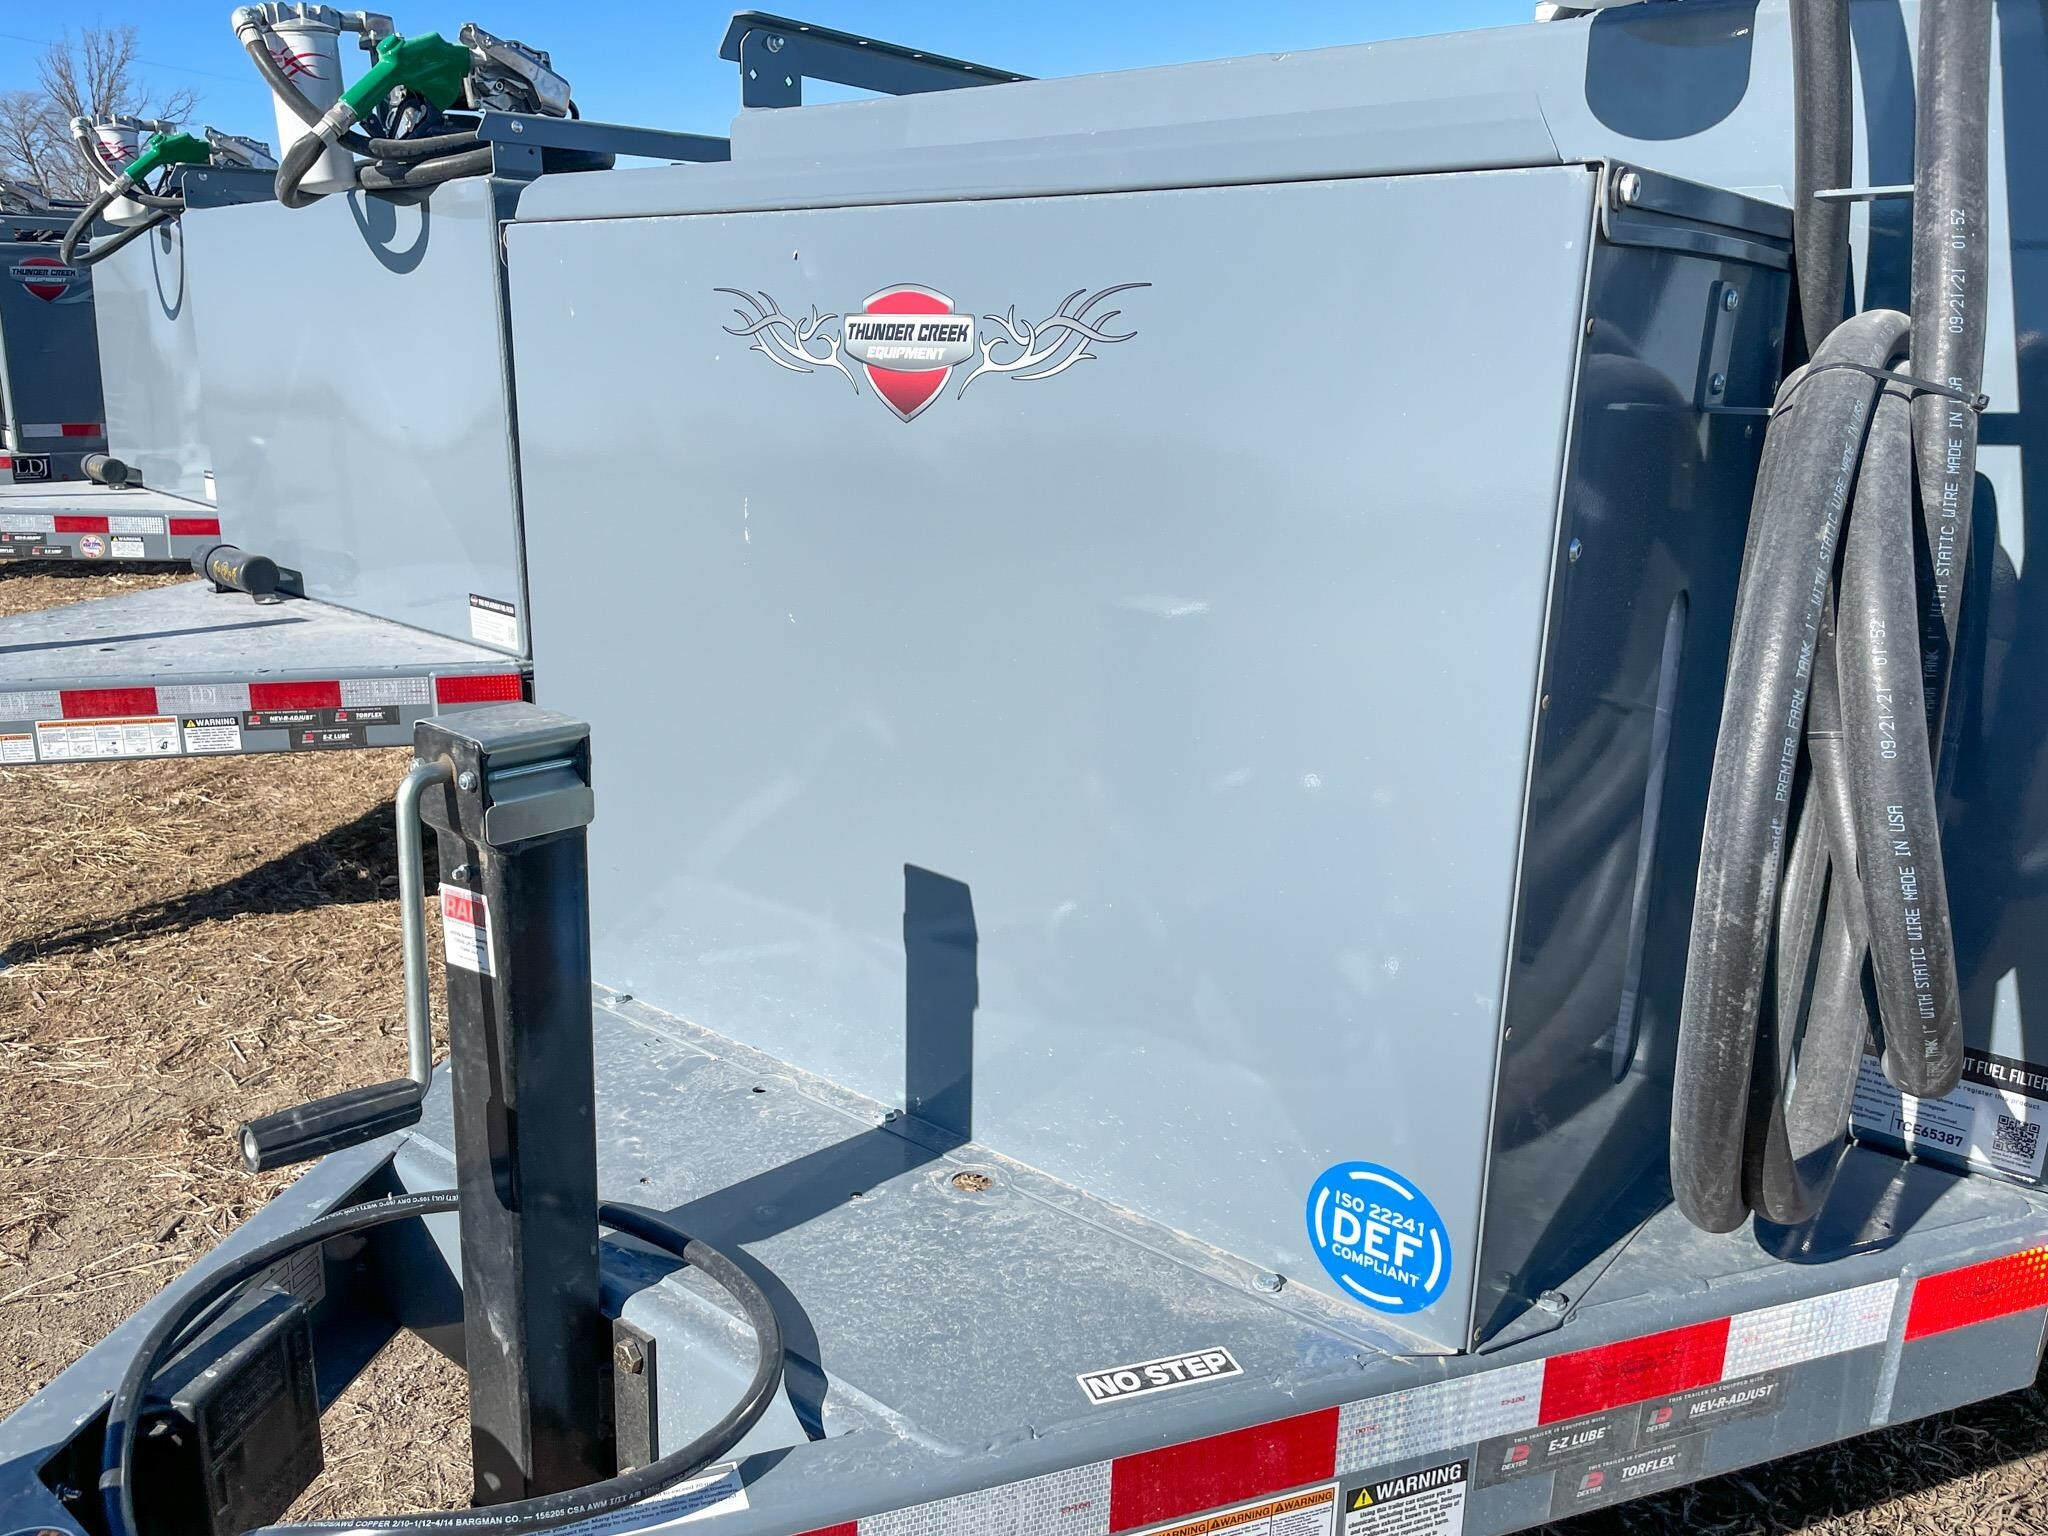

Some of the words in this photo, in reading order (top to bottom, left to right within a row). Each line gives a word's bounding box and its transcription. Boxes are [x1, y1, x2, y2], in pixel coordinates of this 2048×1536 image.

[1951, 208, 1966, 249] 01:52
[1949, 268, 1966, 334] 09/21/21
[847, 322, 914, 343] THUNDER
[917, 322, 970, 343] CREEK
[865, 345, 947, 362] EQUIPMENT
[1852, 399, 1864, 423] USA
[1949, 411, 1963, 429] IN
[1847, 424, 1859, 440] IN
[14, 458, 49, 478] LDJ
[1840, 440, 1855, 475] MADE
[1946, 438, 1962, 475] MADE
[1831, 475, 1847, 511] WIRE
[1941, 481, 1959, 519] WIRE
[1819, 511, 1839, 564] STATIC
[1936, 525, 1955, 577] STATIC
[1810, 567, 1828, 608] WITH
[1869, 620, 1888, 666] 01:52
[1796, 640, 1813, 679] TANK
[195, 717, 236, 728] WARNING
[355, 711, 383, 719] TORFLEX
[1787, 688, 1805, 731] FARM
[1876, 687, 1897, 760] 09/21/21
[1775, 736, 1796, 802] PREMIER
[1886, 804, 1905, 833] USA
[1891, 839, 1912, 857] IN
[1898, 865, 1919, 901] MADE
[1904, 907, 1922, 941] WIRE
[1910, 946, 1930, 990] STATIC
[1918, 996, 1936, 1020] WITH
[1976, 1060, 2008, 1081] FUEL
[2008, 1068, 2048, 1092] FILTER
[1894, 1117, 1964, 1148] TCE65387
[1335, 1189, 1365, 1213] ISO
[1368, 1203, 1425, 1237] 22241
[1332, 1206, 1423, 1268] DEF
[1331, 1242, 1420, 1288] COMPLIANT
[1086, 1371, 1142, 1398] NO
[1143, 1352, 1227, 1386] STEP
[1684, 1389, 1709, 1400] TRAILER
[1718, 1379, 1748, 1392] EQUIPPED
[1689, 1384, 1774, 1415] NEV-R-ADJUST
[1547, 1436, 1570, 1452] E-Z
[1571, 1427, 1607, 1446] LUBE
[1645, 1421, 1671, 1433] DEXTER
[1501, 1460, 1528, 1471] DEXTER
[1621, 1454, 1677, 1479] TORFLEX
[1376, 1463, 1462, 1501] WARNING
[1576, 1486, 1602, 1498] DEXTER
[355, 1520, 390, 1528] COPPER
[455, 1516, 503, 1527] BARGMAN
[504, 1514, 522, 1524] CO.
[535, 1508, 566, 1521] 156205
[566, 1505, 587, 1515] CSA
[587, 1500, 608, 1512] AWM
[1219, 1507, 1271, 1527] WARNING
[1282, 1491, 1333, 1511] WARNING
